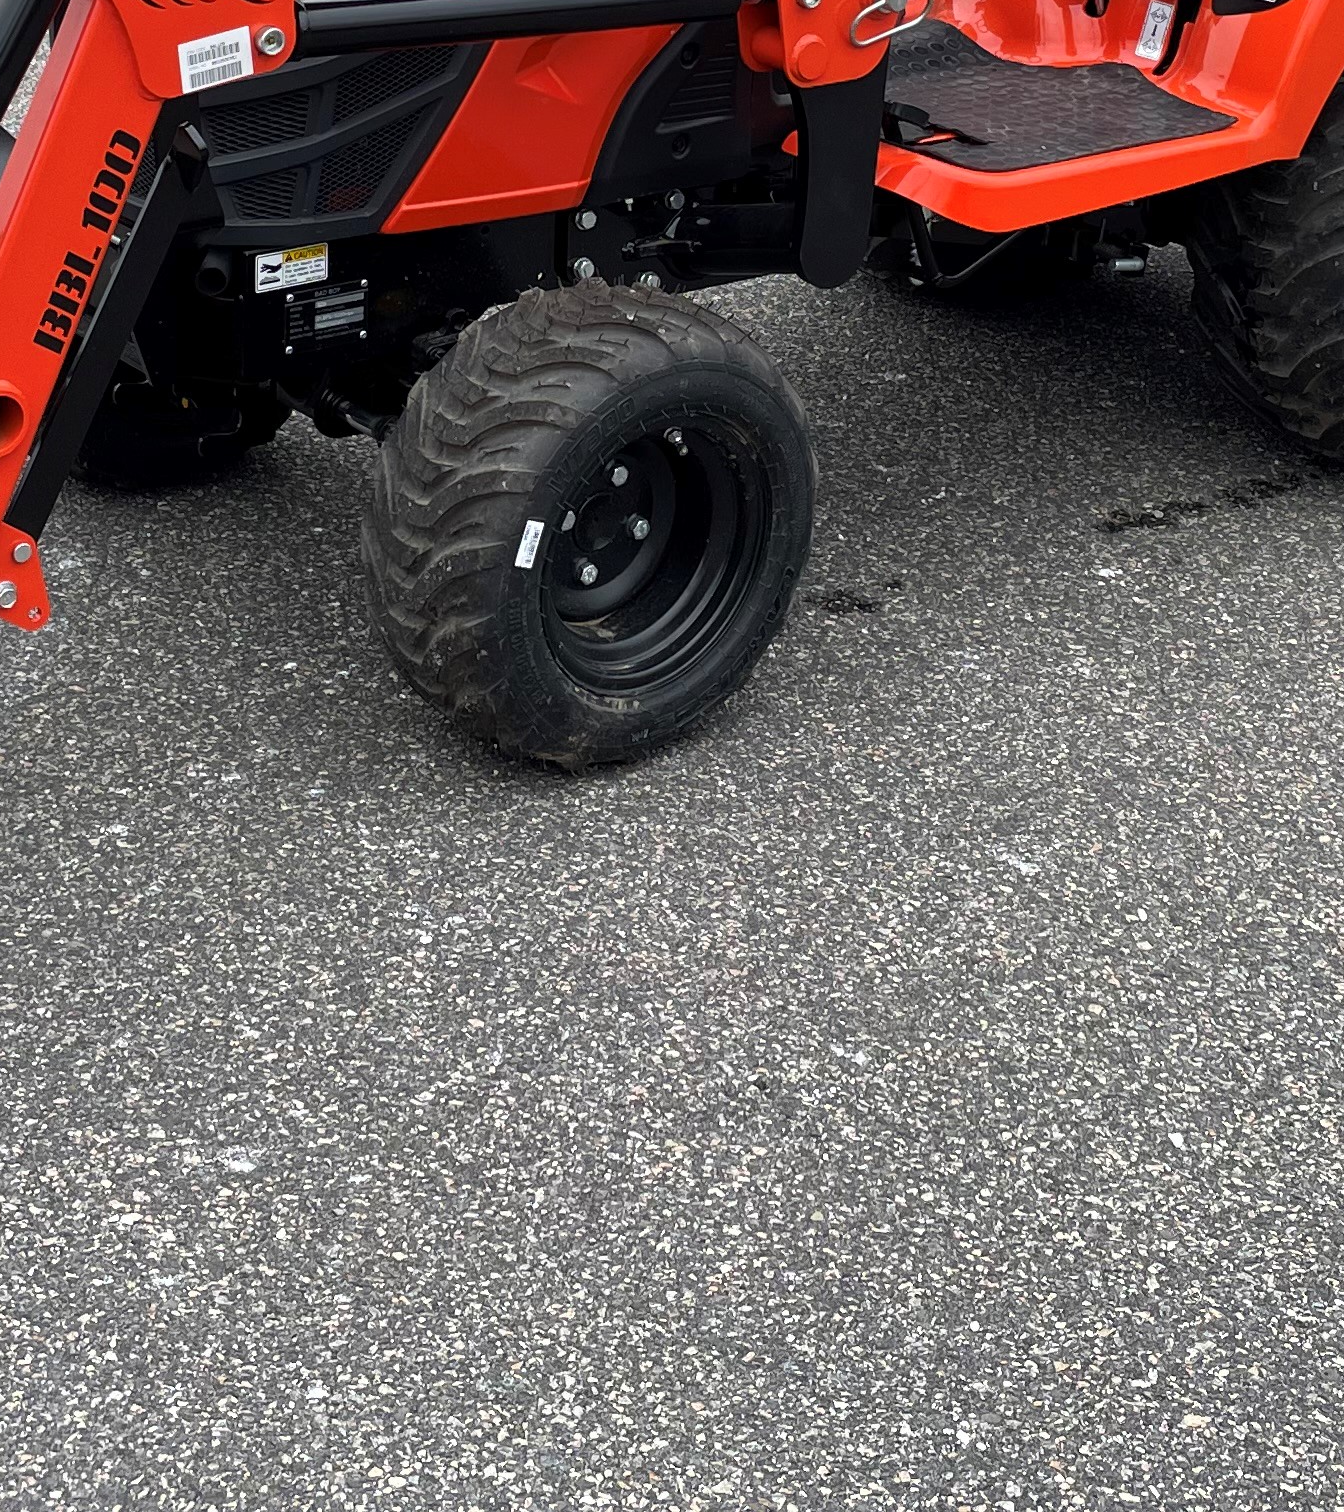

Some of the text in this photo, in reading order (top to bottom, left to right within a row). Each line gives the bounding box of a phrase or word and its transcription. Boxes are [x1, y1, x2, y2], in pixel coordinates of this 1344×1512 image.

[31, 128, 142, 356] BBL 100
[293, 246, 327, 262] CAUTION
